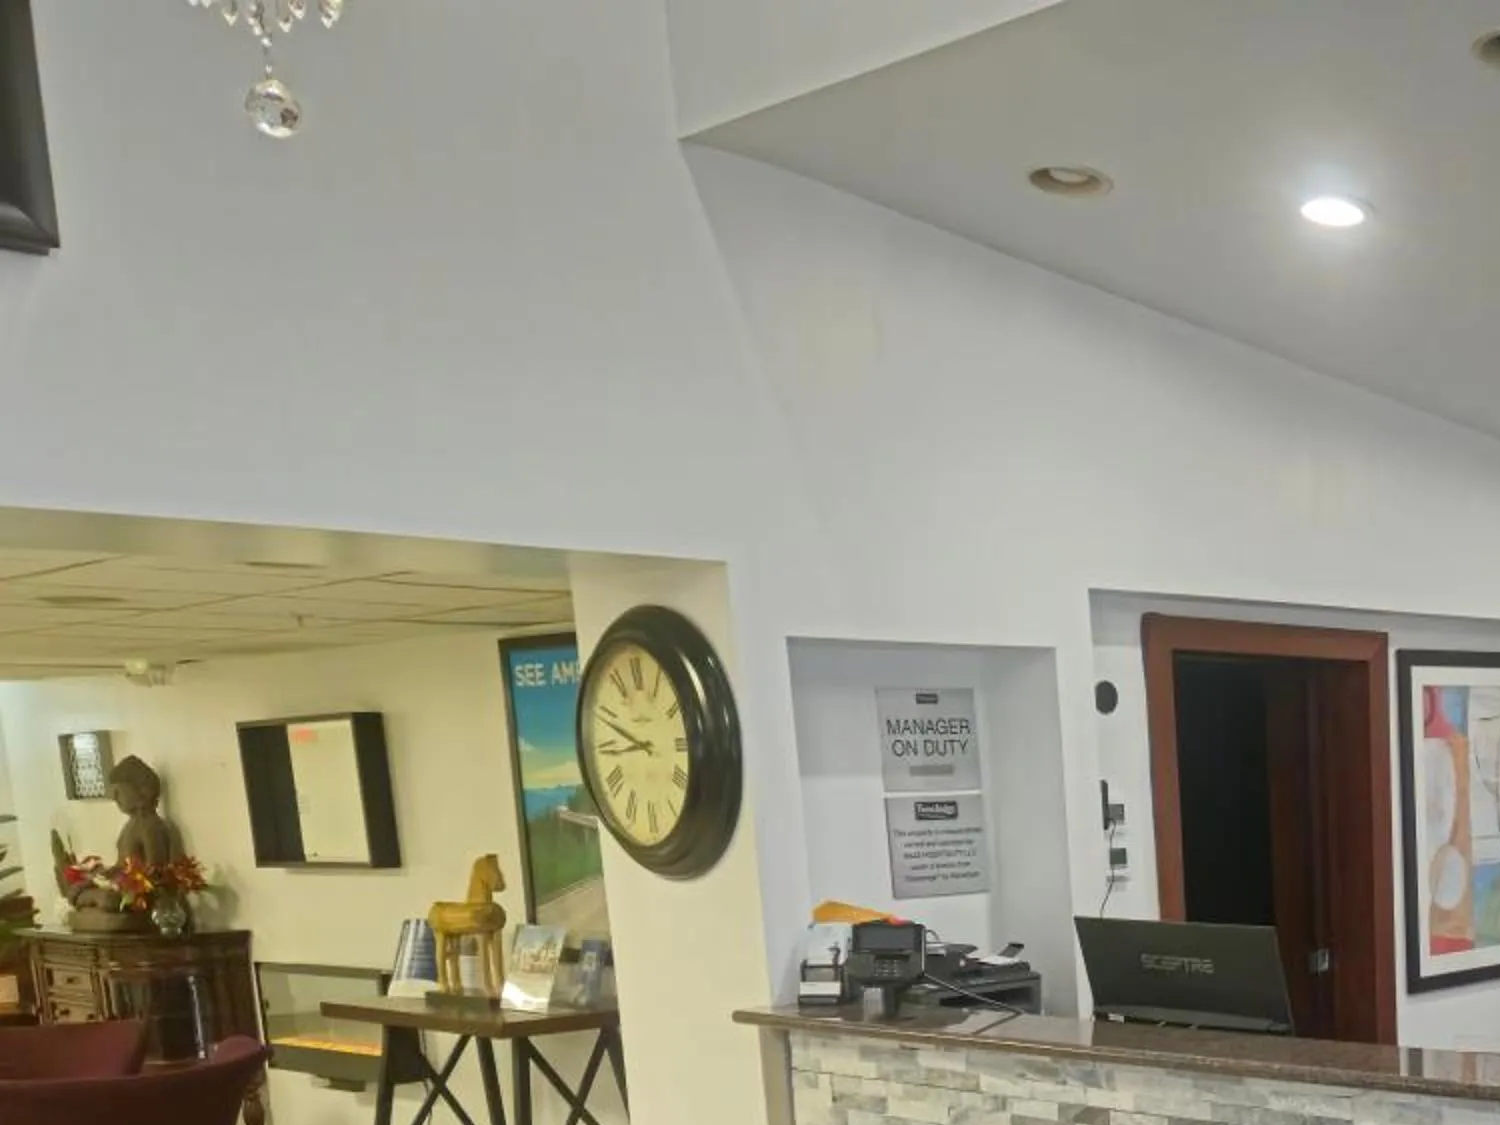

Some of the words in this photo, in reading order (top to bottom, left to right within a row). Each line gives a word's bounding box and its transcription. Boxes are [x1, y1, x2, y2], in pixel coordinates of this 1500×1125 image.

[515, 662, 546, 688] SEE
[551, 660, 581, 686] AM
[886, 718, 970, 736] MANAGER
[892, 739, 918, 758] ON
[923, 739, 969, 757] DUTY
[1140, 953, 1214, 974] SCEPTRE
